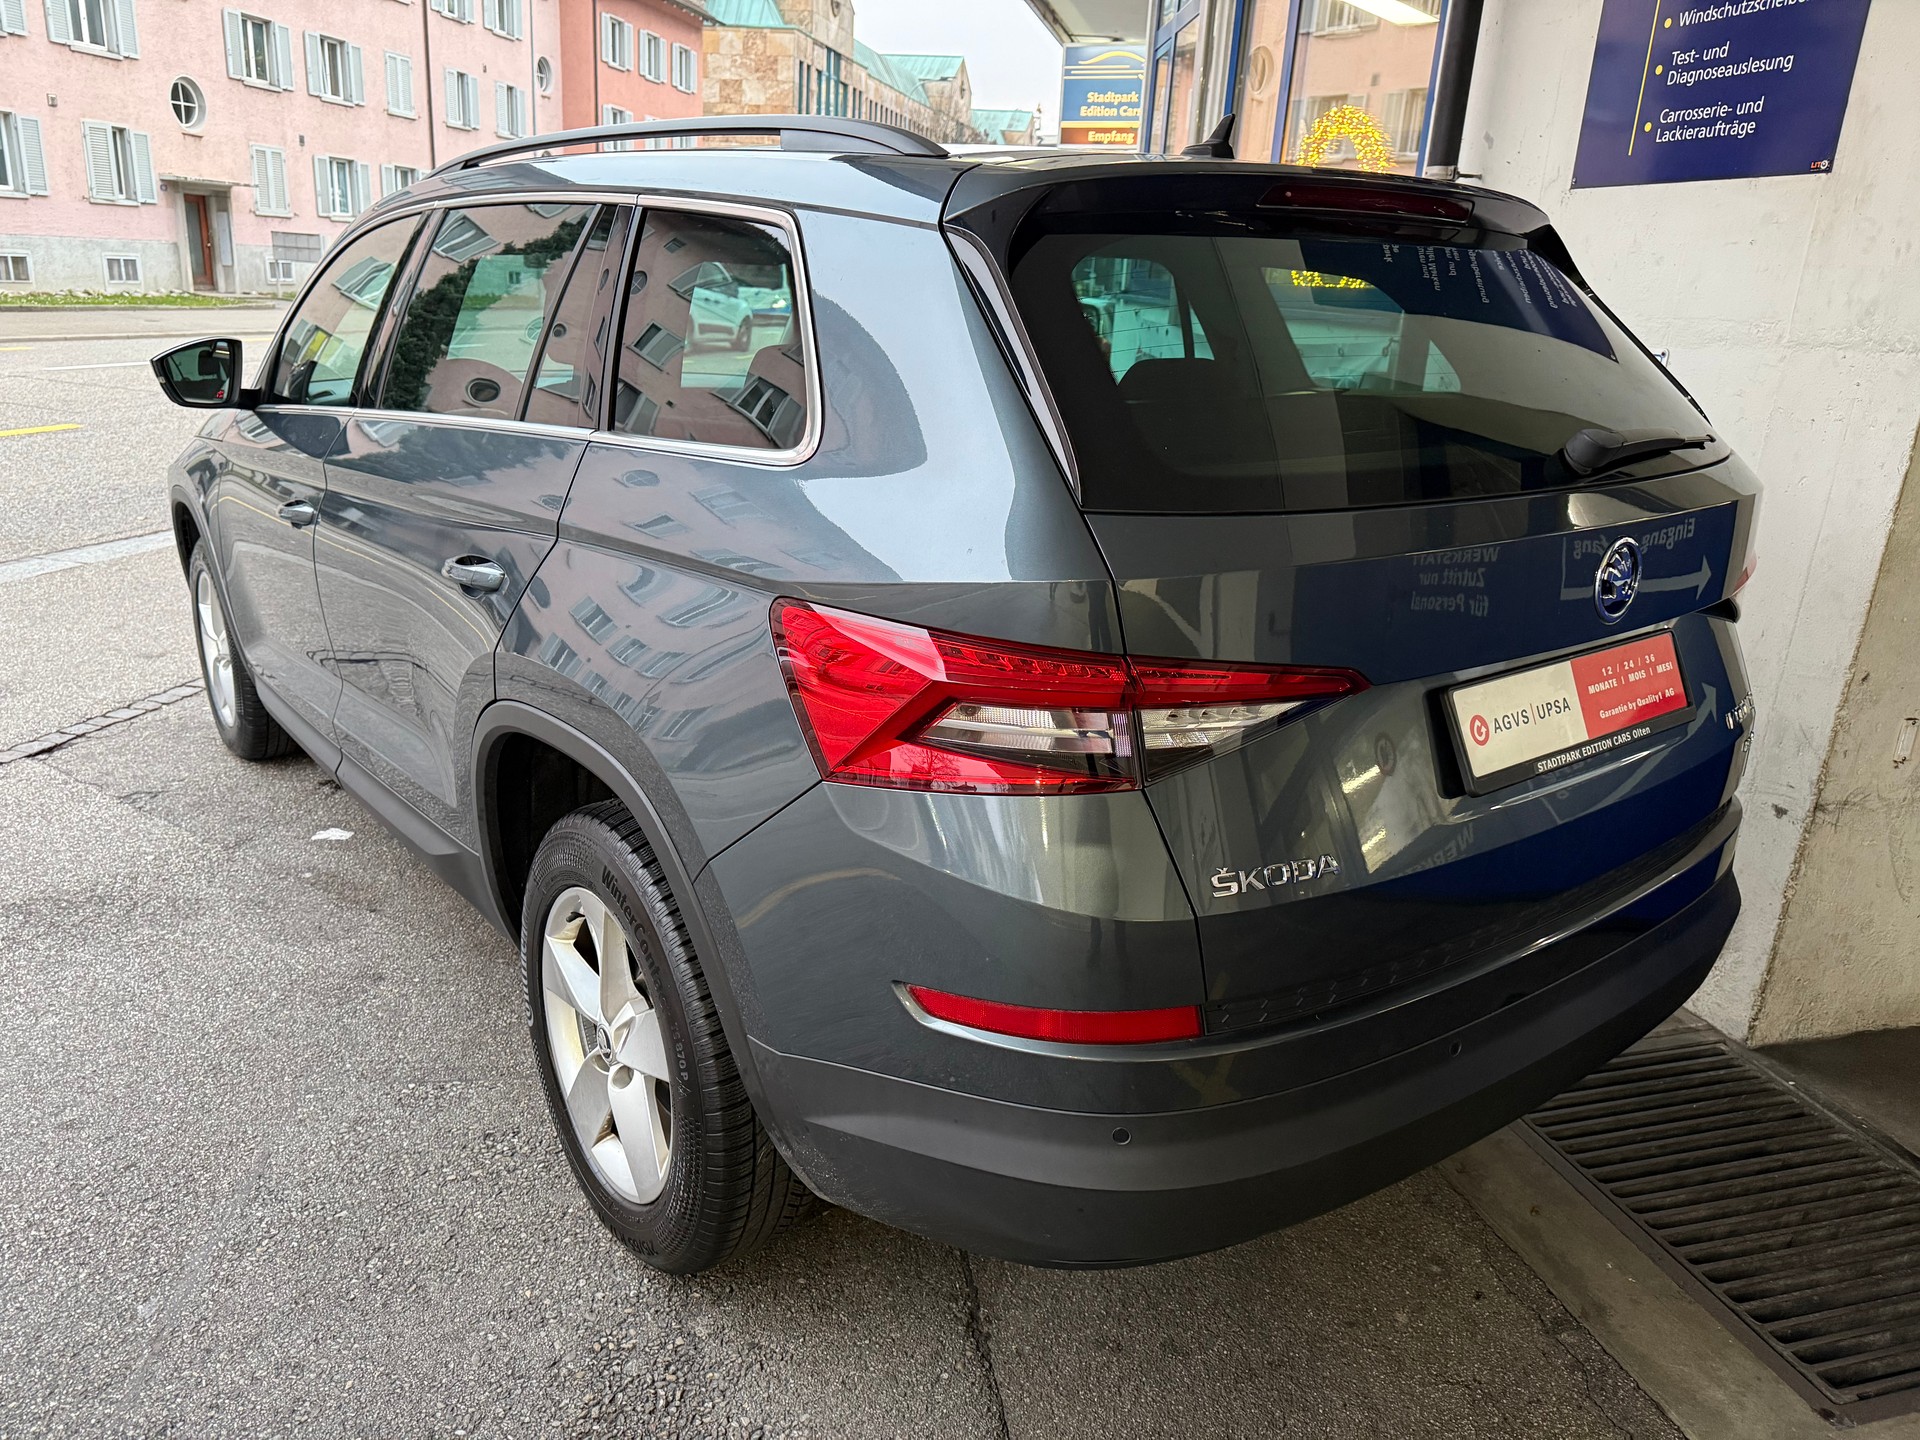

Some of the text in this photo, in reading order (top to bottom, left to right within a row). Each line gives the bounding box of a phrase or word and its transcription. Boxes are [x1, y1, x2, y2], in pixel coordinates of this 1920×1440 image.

[1679, 0, 1809, 27] Windschutzschei
[1671, 41, 1730, 66] Test- und
[1666, 53, 1794, 87] Diagnoseauslesung
[1080, 105, 1118, 117] Edition
[1087, 91, 1139, 105] Stadtpark
[1659, 96, 1765, 124] Carrosserie- und
[1088, 130, 1135, 144] Empfang
[1655, 120, 1756, 143] Lackieraufträge
[1587, 678, 1618, 695] MONATE
[1628, 669, 1647, 682] MOIS
[1656, 661, 1673, 674] MESI
[1602, 666, 1613, 677] 12
[1624, 660, 1634, 670] 24
[1645, 653, 1655, 664] 36
[1493, 696, 1572, 734] AGVS UPSA
[1600, 688, 1675, 719] Garantie by Quality1 AG
[1537, 726, 1651, 772] STADTPARK EDITION CARS Olten
[1211, 853, 1341, 898] ŠKODA
[601, 864, 672, 1012] WinterConta
[674, 1041, 688, 1069] 870
